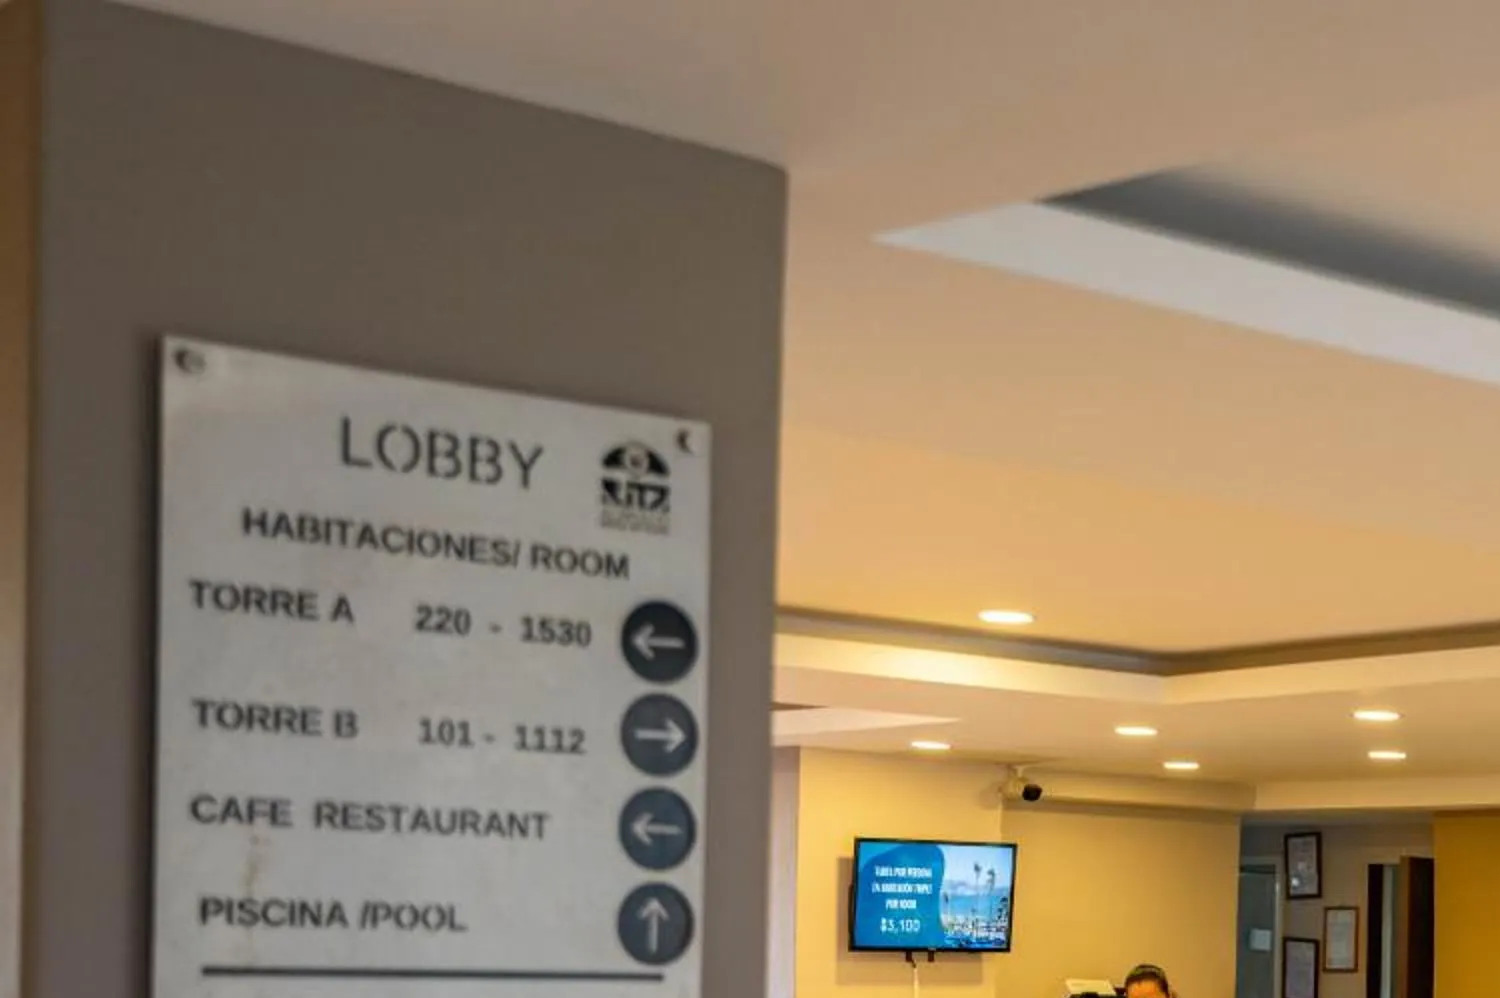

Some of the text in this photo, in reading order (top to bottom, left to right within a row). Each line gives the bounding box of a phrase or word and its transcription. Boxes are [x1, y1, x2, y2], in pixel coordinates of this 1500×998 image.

[339, 415, 544, 489] LOBBY
[240, 506, 630, 579] HABITACIONES/ ROOM
[188, 578, 318, 621] TORRE
[330, 595, 354, 623] A
[414, 603, 472, 637] 220
[521, 615, 593, 648] 1530
[191, 697, 321, 736] TORRE
[333, 709, 359, 739] B
[419, 716, 474, 748] 101
[515, 724, 586, 756] 1112
[188, 793, 549, 840] CAFE RESTAURANT
[198, 896, 467, 933] PISCINA /POOL
